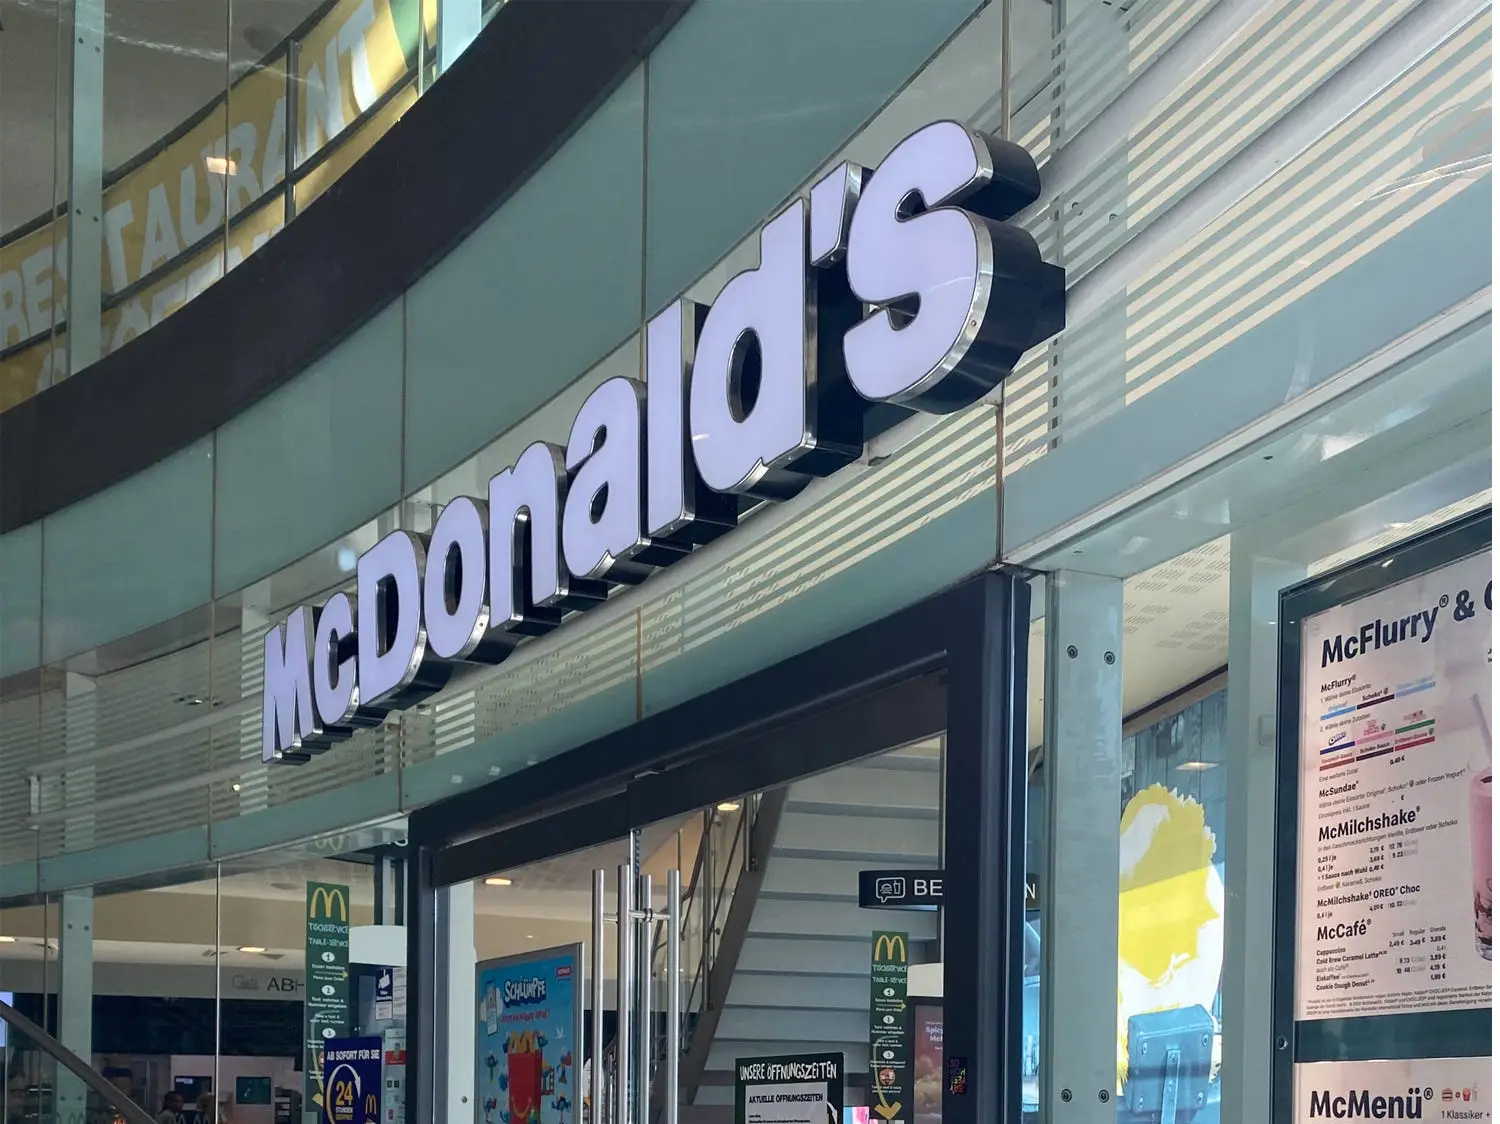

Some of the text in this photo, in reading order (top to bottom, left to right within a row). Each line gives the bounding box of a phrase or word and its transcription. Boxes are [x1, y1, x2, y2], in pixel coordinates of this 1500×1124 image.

[0, 0, 382, 346] RETAURANT
[262, 119, 1003, 764] McDonald's
[1321, 594, 1449, 668] McFlurry®
[1454, 590, 1475, 621] &
[914, 880, 943, 896] BE
[1400, 884, 1420, 895] Choc
[740, 1063, 765, 1080] UNSERE
[336, 1081, 352, 1105] 24
[749, 1095, 774, 1104] AKTUELLE
[1310, 1086, 1434, 1119] McMenü®
[1447, 1110, 1483, 1119] Klassiker
